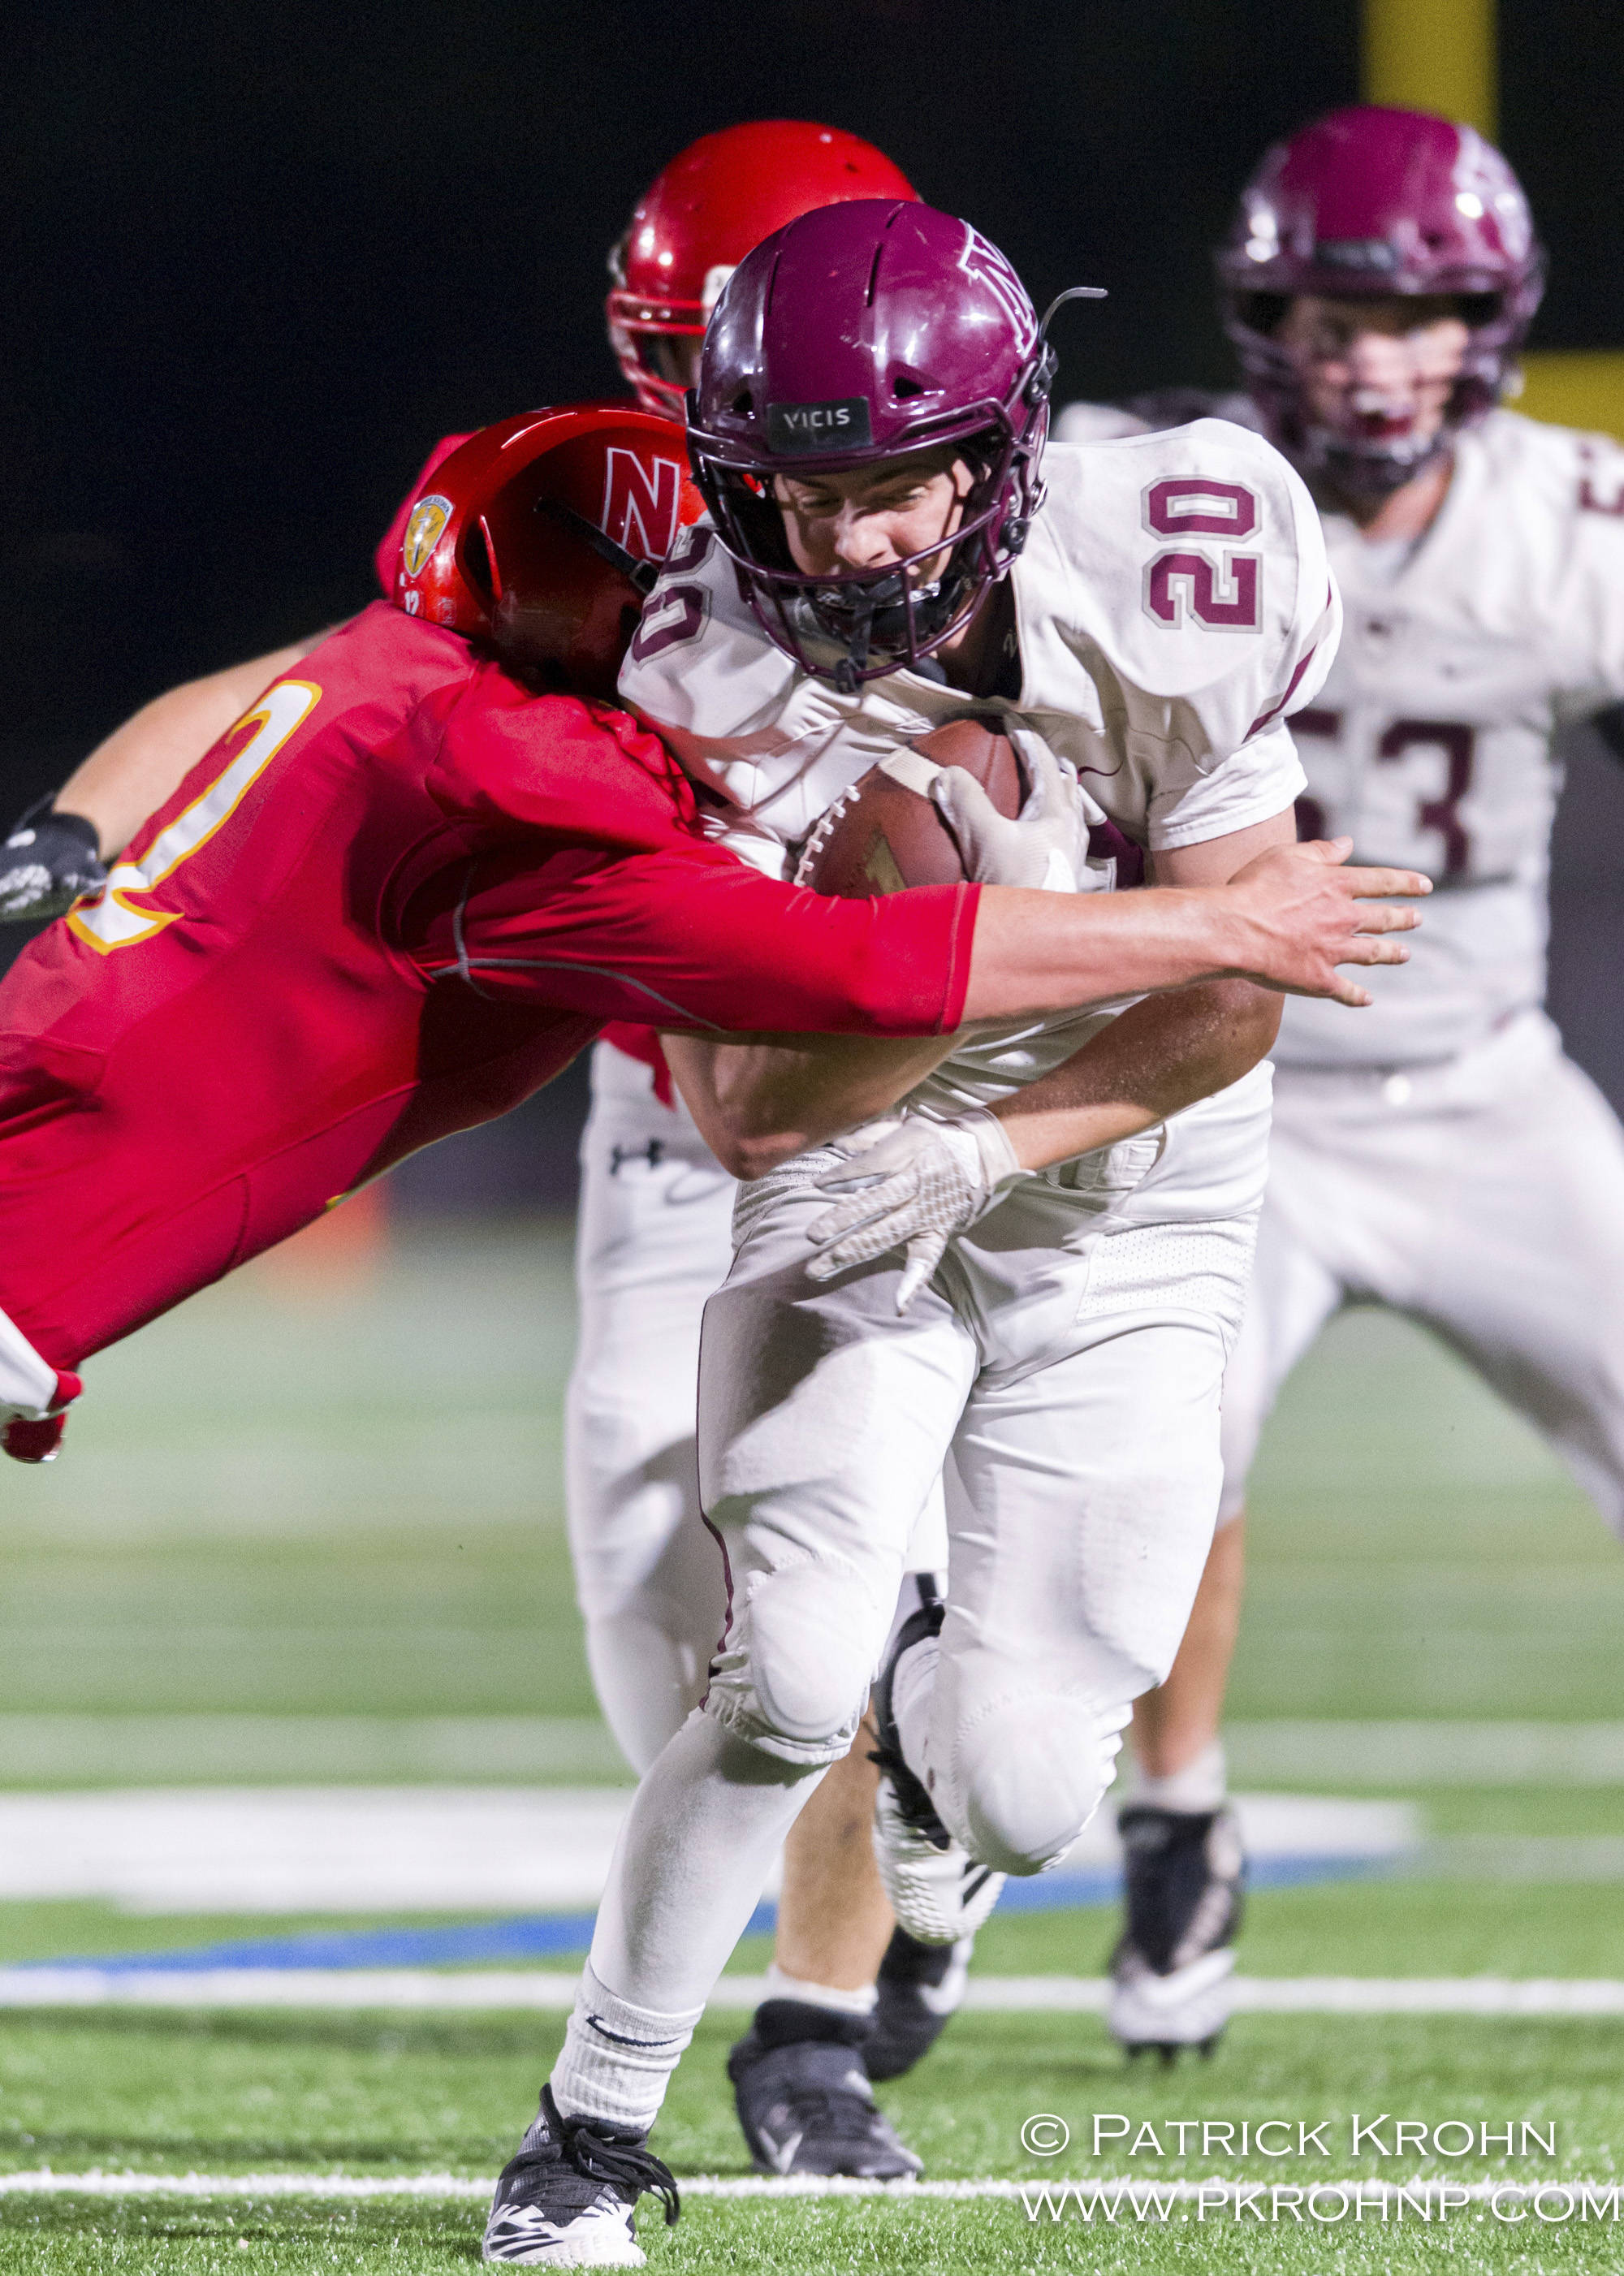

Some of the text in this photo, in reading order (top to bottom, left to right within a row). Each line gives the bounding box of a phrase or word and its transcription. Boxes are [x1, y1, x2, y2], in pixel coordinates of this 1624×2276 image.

[783, 408, 850, 430] VICIS
[601, 447, 680, 562] N
[1140, 473, 1263, 634] 20
